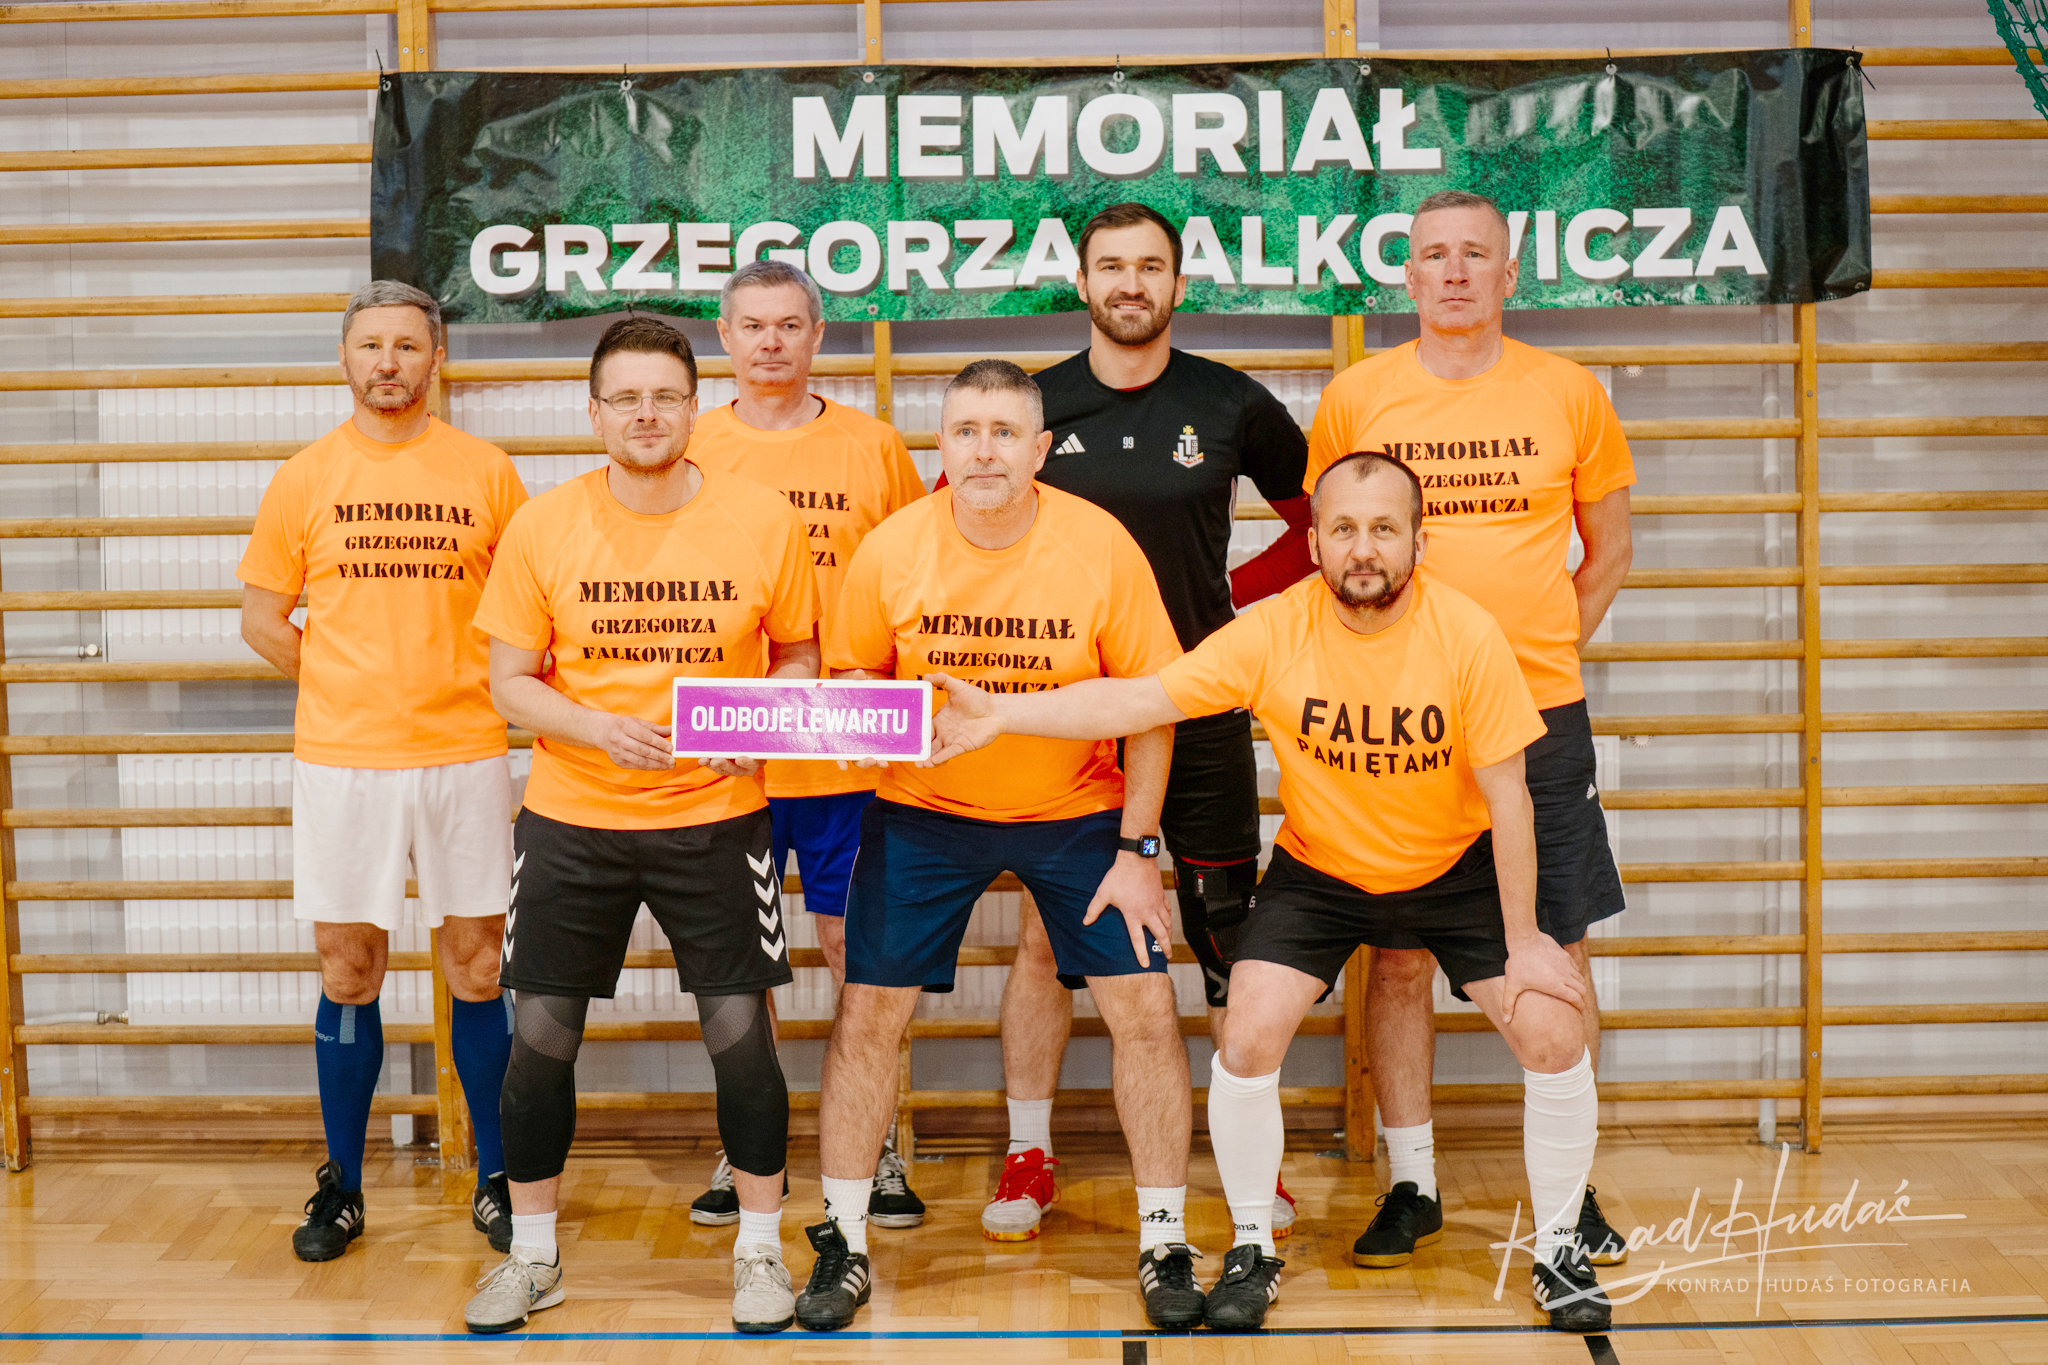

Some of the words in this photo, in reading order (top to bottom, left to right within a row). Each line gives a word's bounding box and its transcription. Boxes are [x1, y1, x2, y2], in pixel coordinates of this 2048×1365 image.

[792, 88, 1443, 180] MEMORIAŁ
[470, 217, 1082, 294] GRZEGORZA
[1178, 205, 1769, 286] ALKOICZA
[1122, 436, 1134, 449] 99
[1382, 437, 1539, 461] MEMORIAŁ
[1416, 471, 1520, 488] ZEGORZA
[334, 502, 475, 527] MEMORIAŁ
[345, 536, 459, 551] GRZEGORZA
[338, 562, 464, 580] FALKOWICZA
[579, 580, 738, 602] MEMORIAŁ
[591, 618, 717, 634] GRZEGORZA
[918, 614, 1075, 639] MEMORIAŁ
[582, 646, 724, 663] FALKOWICZA
[928, 650, 1052, 670] GRZEGORZA
[691, 706, 792, 732] OLDBOJE
[797, 707, 908, 734] LEWARTU
[1301, 697, 1445, 746] FALKO
[1296, 737, 1453, 777] PAMIĘTAMY
[1234, 1223, 1258, 1231] oma
